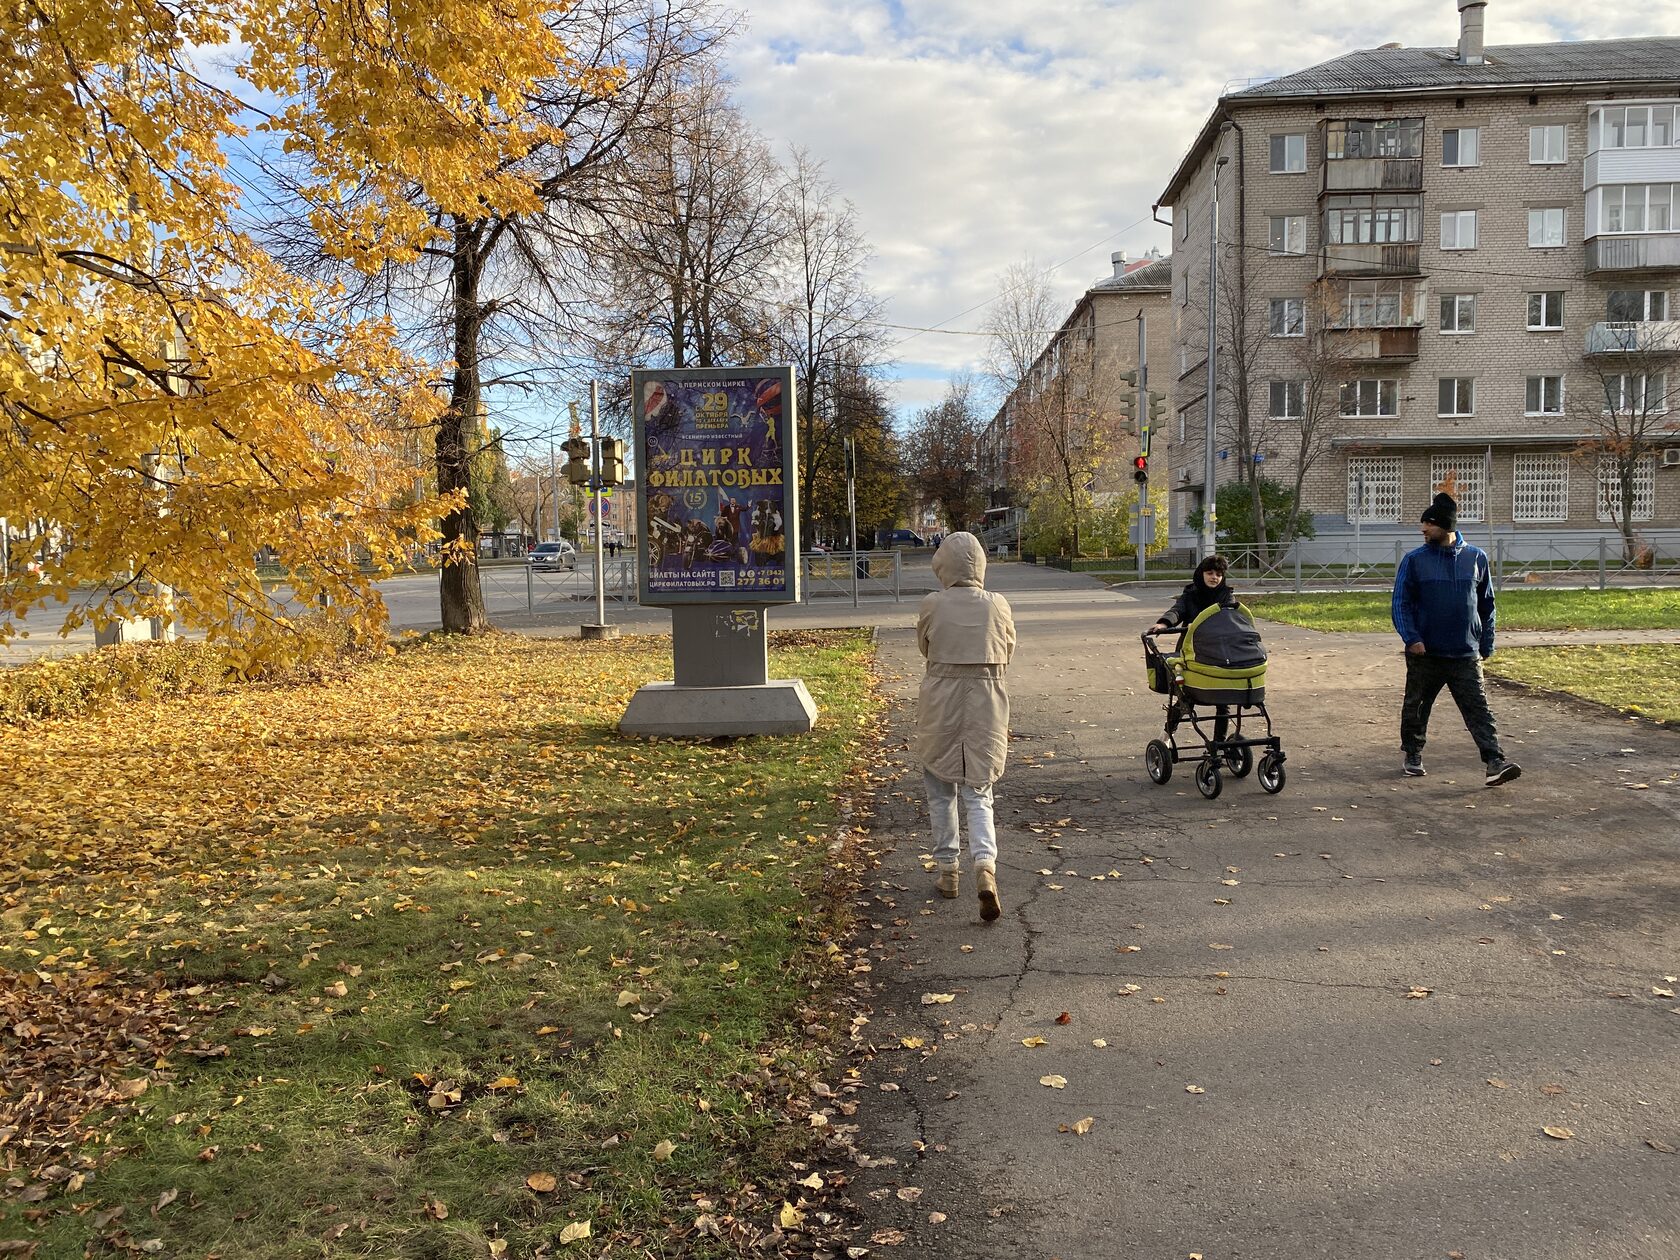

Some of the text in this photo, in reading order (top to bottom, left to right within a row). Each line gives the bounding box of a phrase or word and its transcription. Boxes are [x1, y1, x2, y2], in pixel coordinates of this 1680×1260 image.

[722, 380, 745, 388] ЦИРКЕ
[702, 392, 728, 411] 29
[680, 447, 752, 467] ЦИРК
[649, 468, 783, 489] ФИЛАТОВЫХ
[690, 492, 702, 503] 15
[649, 571, 680, 579] БИЛЕТЫ
[693, 569, 716, 578] САЙТЕ
[649, 580, 716, 588] ЦИРКФИЛАТОВЫХ.РФ
[737, 577, 785, 586] 277 36 01
